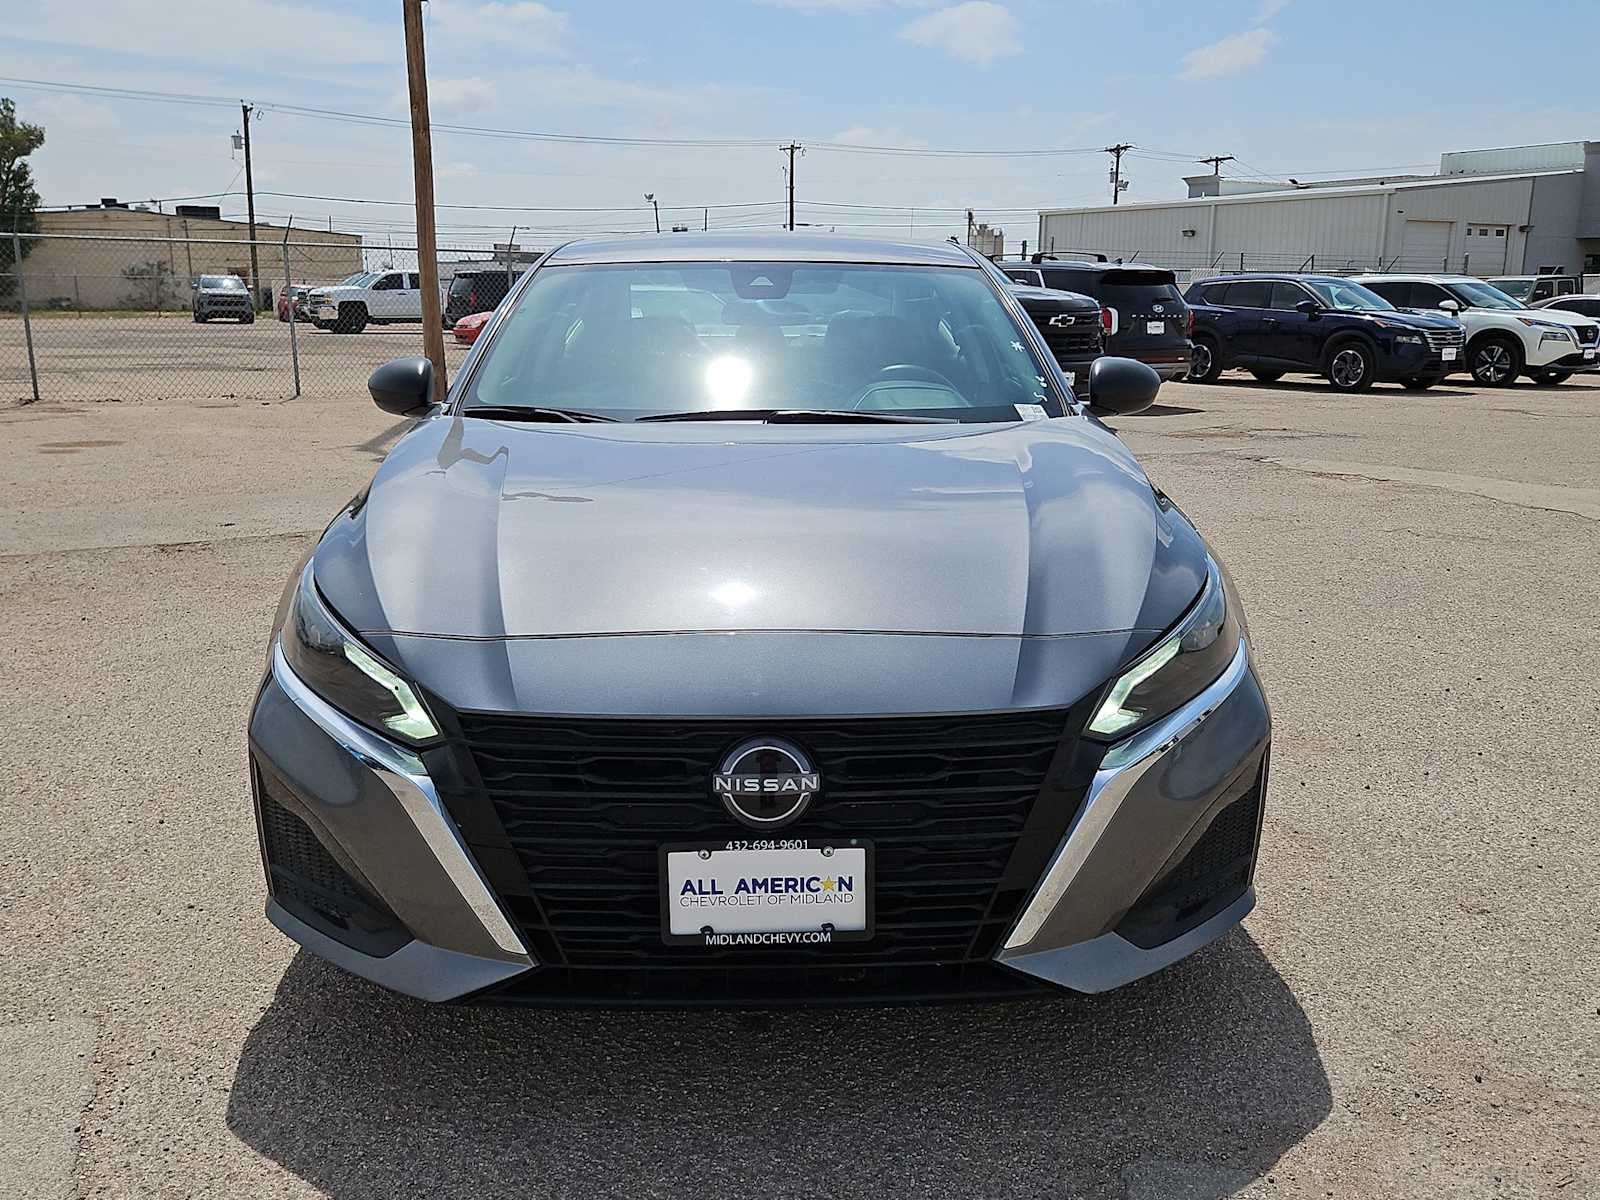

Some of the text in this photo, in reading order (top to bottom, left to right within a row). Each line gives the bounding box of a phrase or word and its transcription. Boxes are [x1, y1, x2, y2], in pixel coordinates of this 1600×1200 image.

[715, 776, 818, 792] NISSAN
[725, 839, 808, 851] 432-694-9601
[680, 876, 853, 896] ALL AMERICN
[680, 893, 854, 907] CHEVROLET OF MIDLAND
[705, 932, 831, 945] MIDLANDCHEVY.COM
